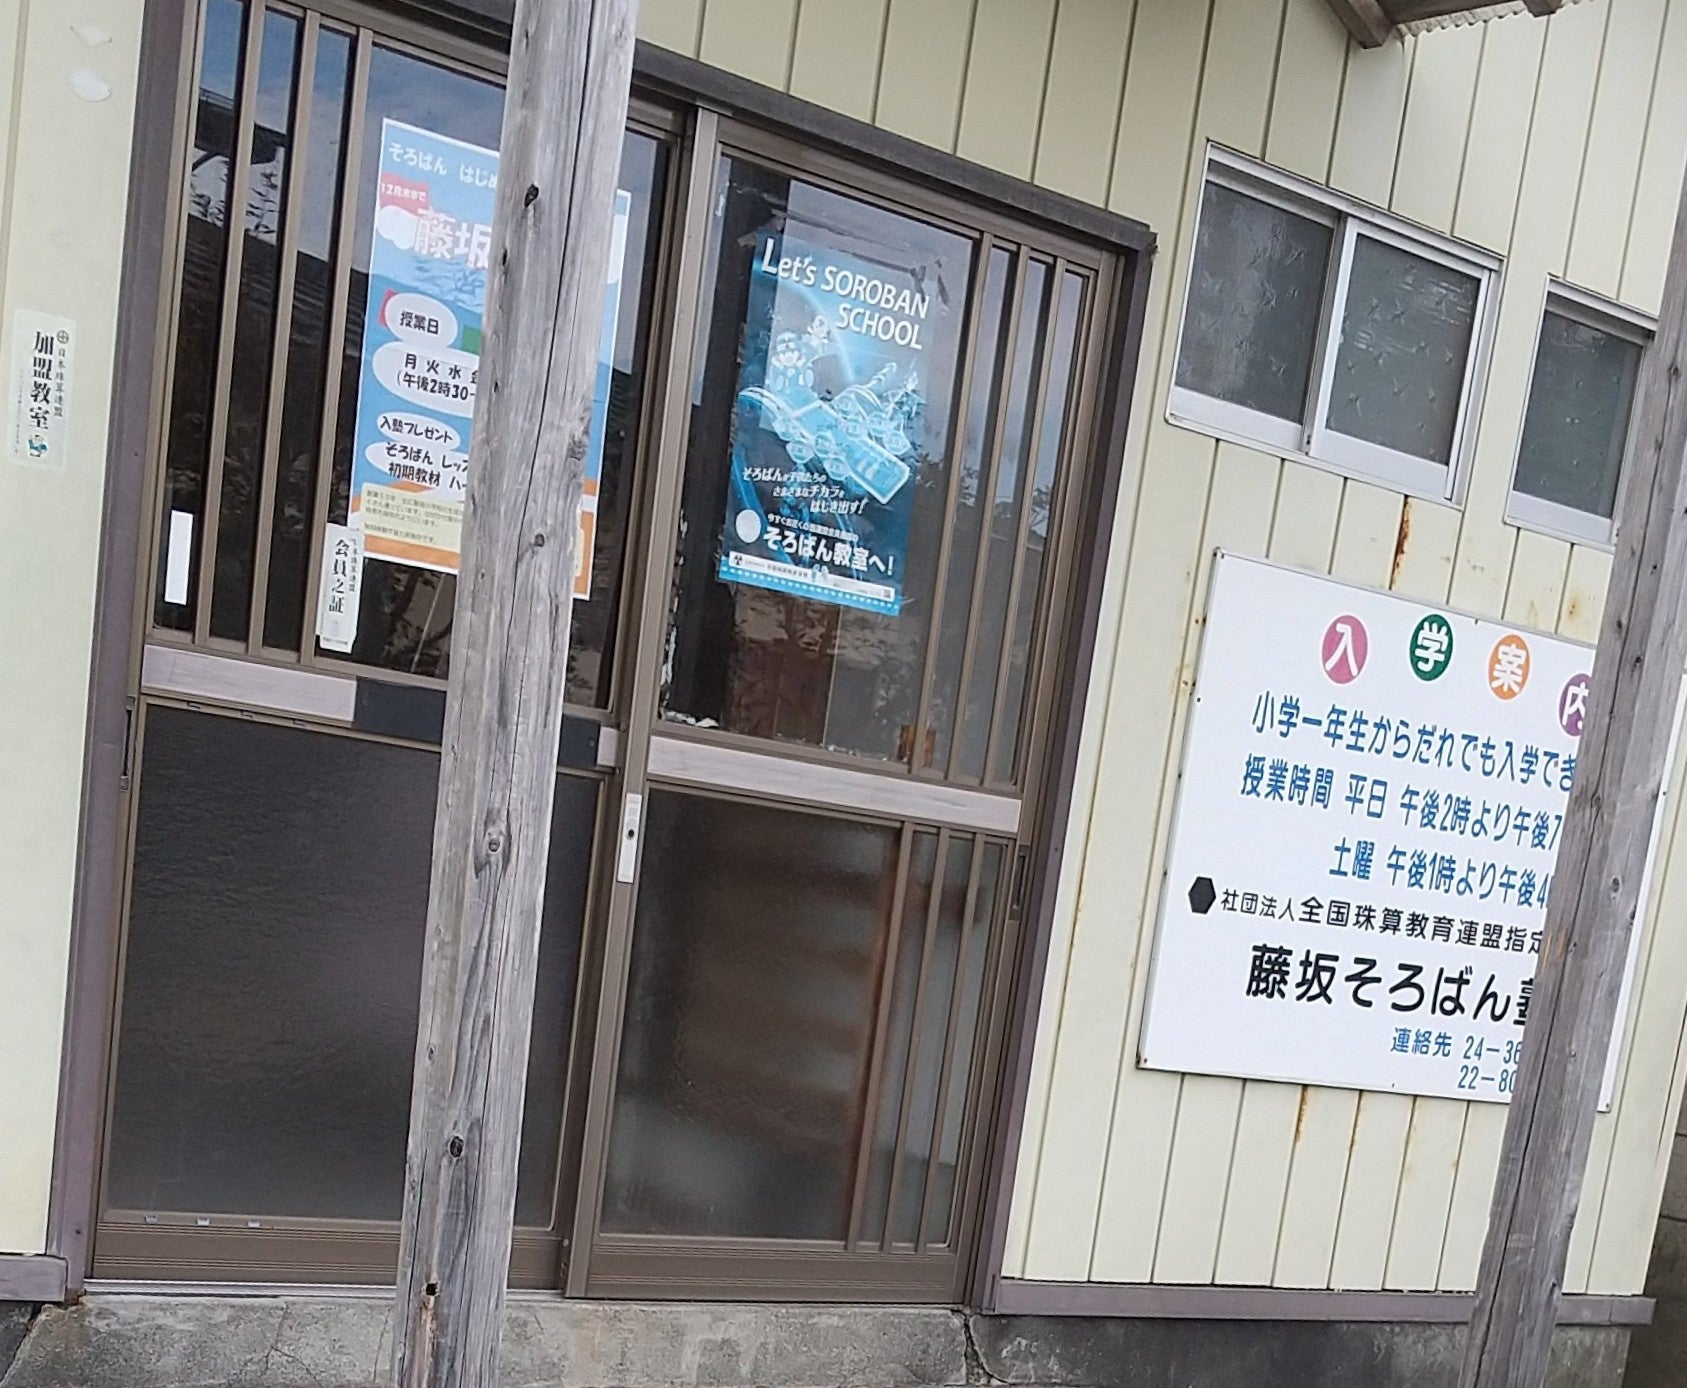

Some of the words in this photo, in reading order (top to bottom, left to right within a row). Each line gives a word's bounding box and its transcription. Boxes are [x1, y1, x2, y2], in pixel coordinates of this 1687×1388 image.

[389, 142, 448, 175] そろばん
[415, 206, 492, 269] 藤坂
[761, 238, 818, 286] Let's
[821, 266, 930, 319] SOROBAN
[400, 311, 440, 335] 授業日
[836, 303, 923, 350] SCHOOL
[30, 331, 54, 429] 加盟教室
[404, 353, 417, 370] 月
[426, 359, 440, 375] 火
[448, 364, 462, 380] 水
[385, 441, 434, 465] そろばん
[388, 461, 441, 487] 初期教材
[328, 539, 350, 614] 会員之証
[1253, 690, 1577, 792] 小学一年生からだれでも入学でき
[1240, 753, 1333, 810] 授業時間
[1344, 773, 1389, 819] 平日
[1399, 785, 1563, 851] 午後2時より午後7
[1328, 839, 1376, 881] 土曜
[1386, 844, 1549, 909] 午後1時より午後4
[1390, 1027, 1453, 1057] 連絡先
